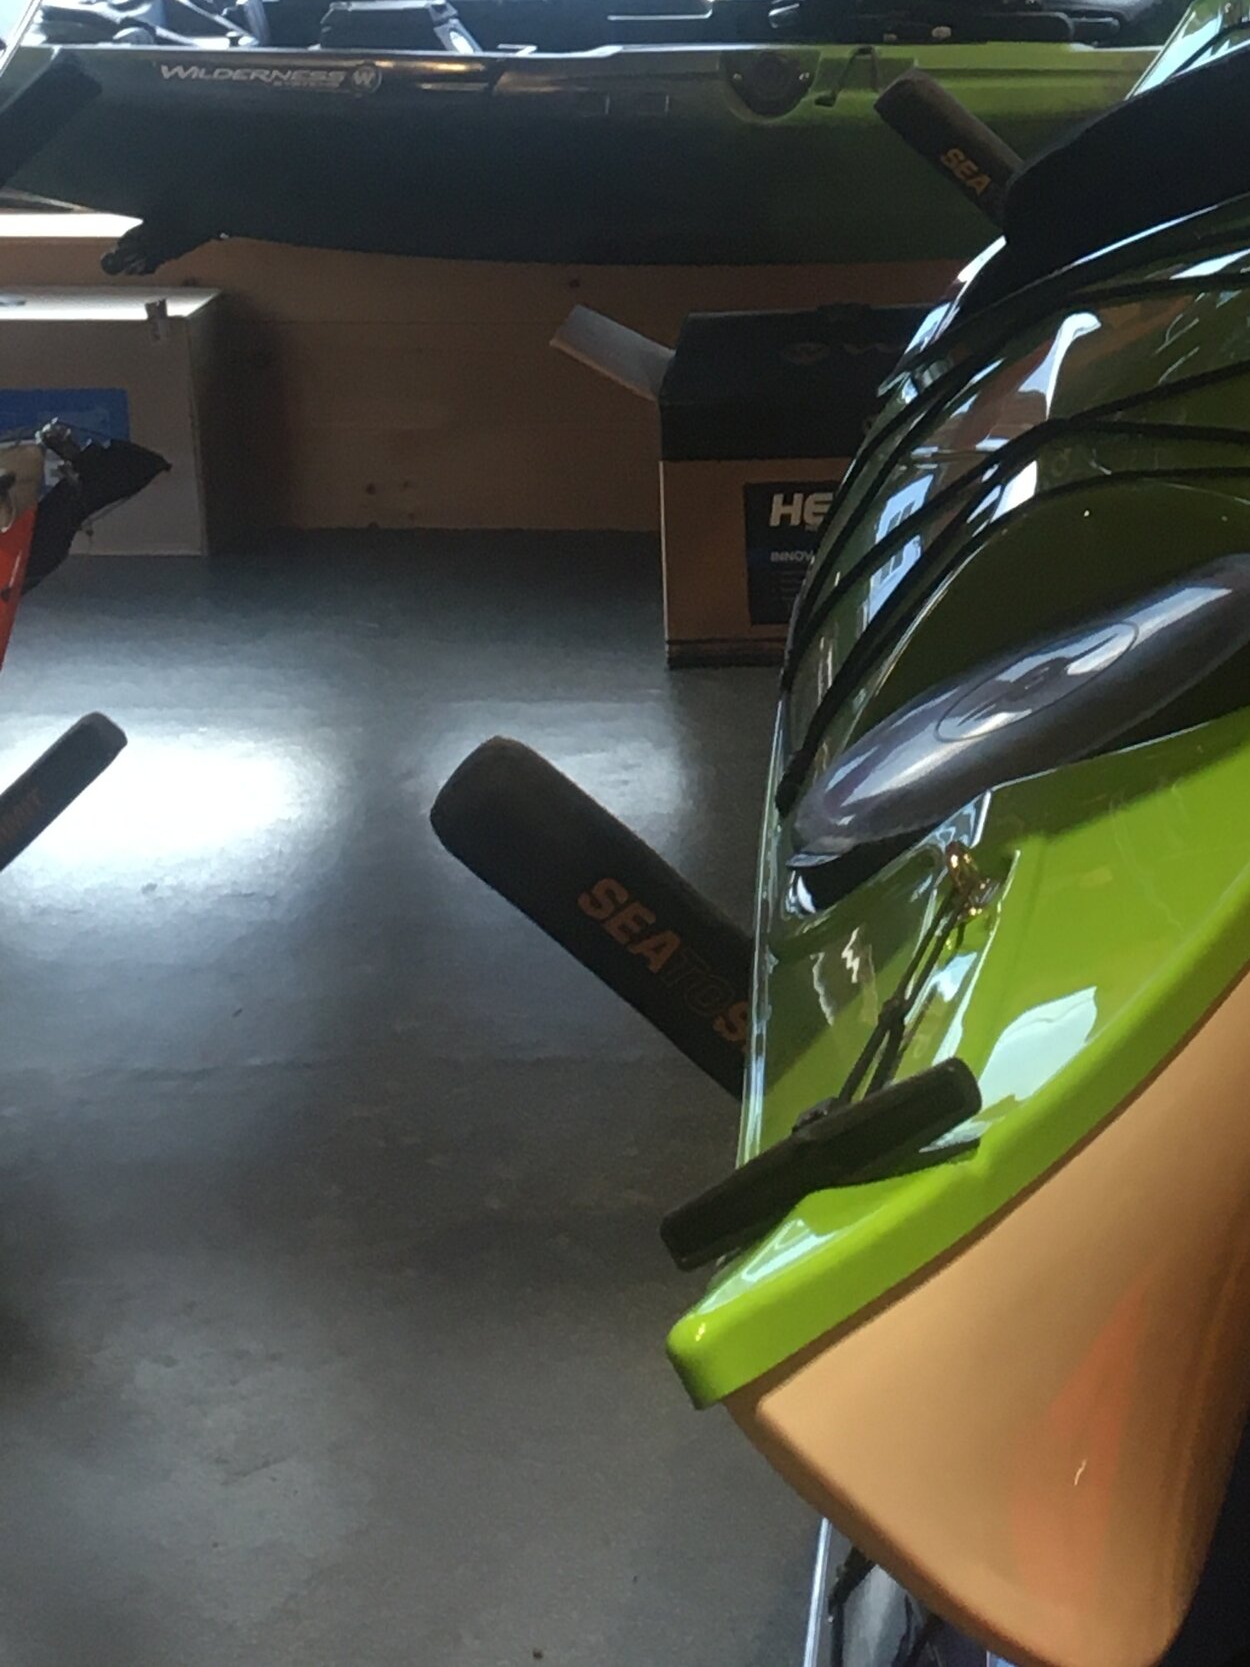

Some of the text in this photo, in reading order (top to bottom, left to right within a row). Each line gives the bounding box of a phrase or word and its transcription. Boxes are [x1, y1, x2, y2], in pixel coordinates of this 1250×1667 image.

[161, 65, 345, 82] WILDERNESS
[939, 147, 993, 197] SEA
[769, 492, 833, 530] HE
[770, 549, 814, 563] INNOV
[576, 877, 681, 974] SEA
